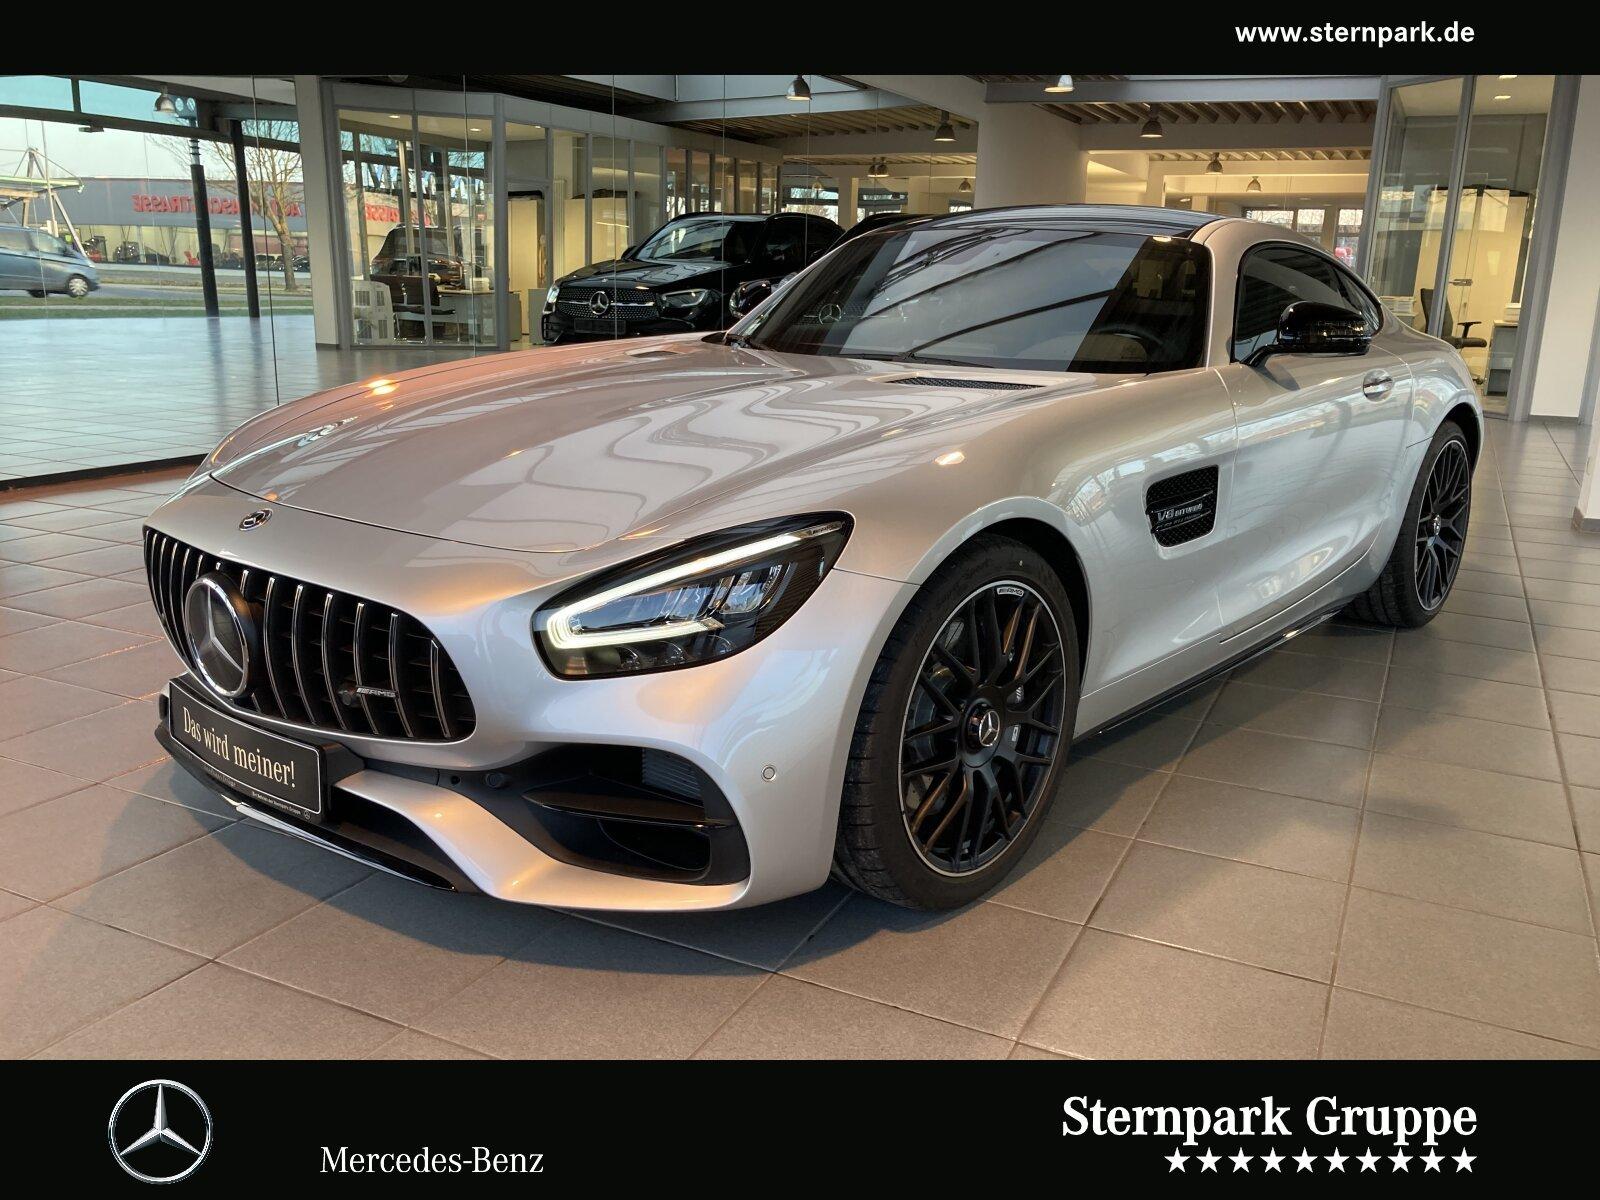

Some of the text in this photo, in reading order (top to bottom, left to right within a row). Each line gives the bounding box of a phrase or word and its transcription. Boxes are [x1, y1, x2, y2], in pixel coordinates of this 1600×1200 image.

[1157, 508, 1175, 522] V8
[183, 707, 201, 742] Das
[203, 727, 230, 761] wird
[233, 745, 296, 788] meiner!
